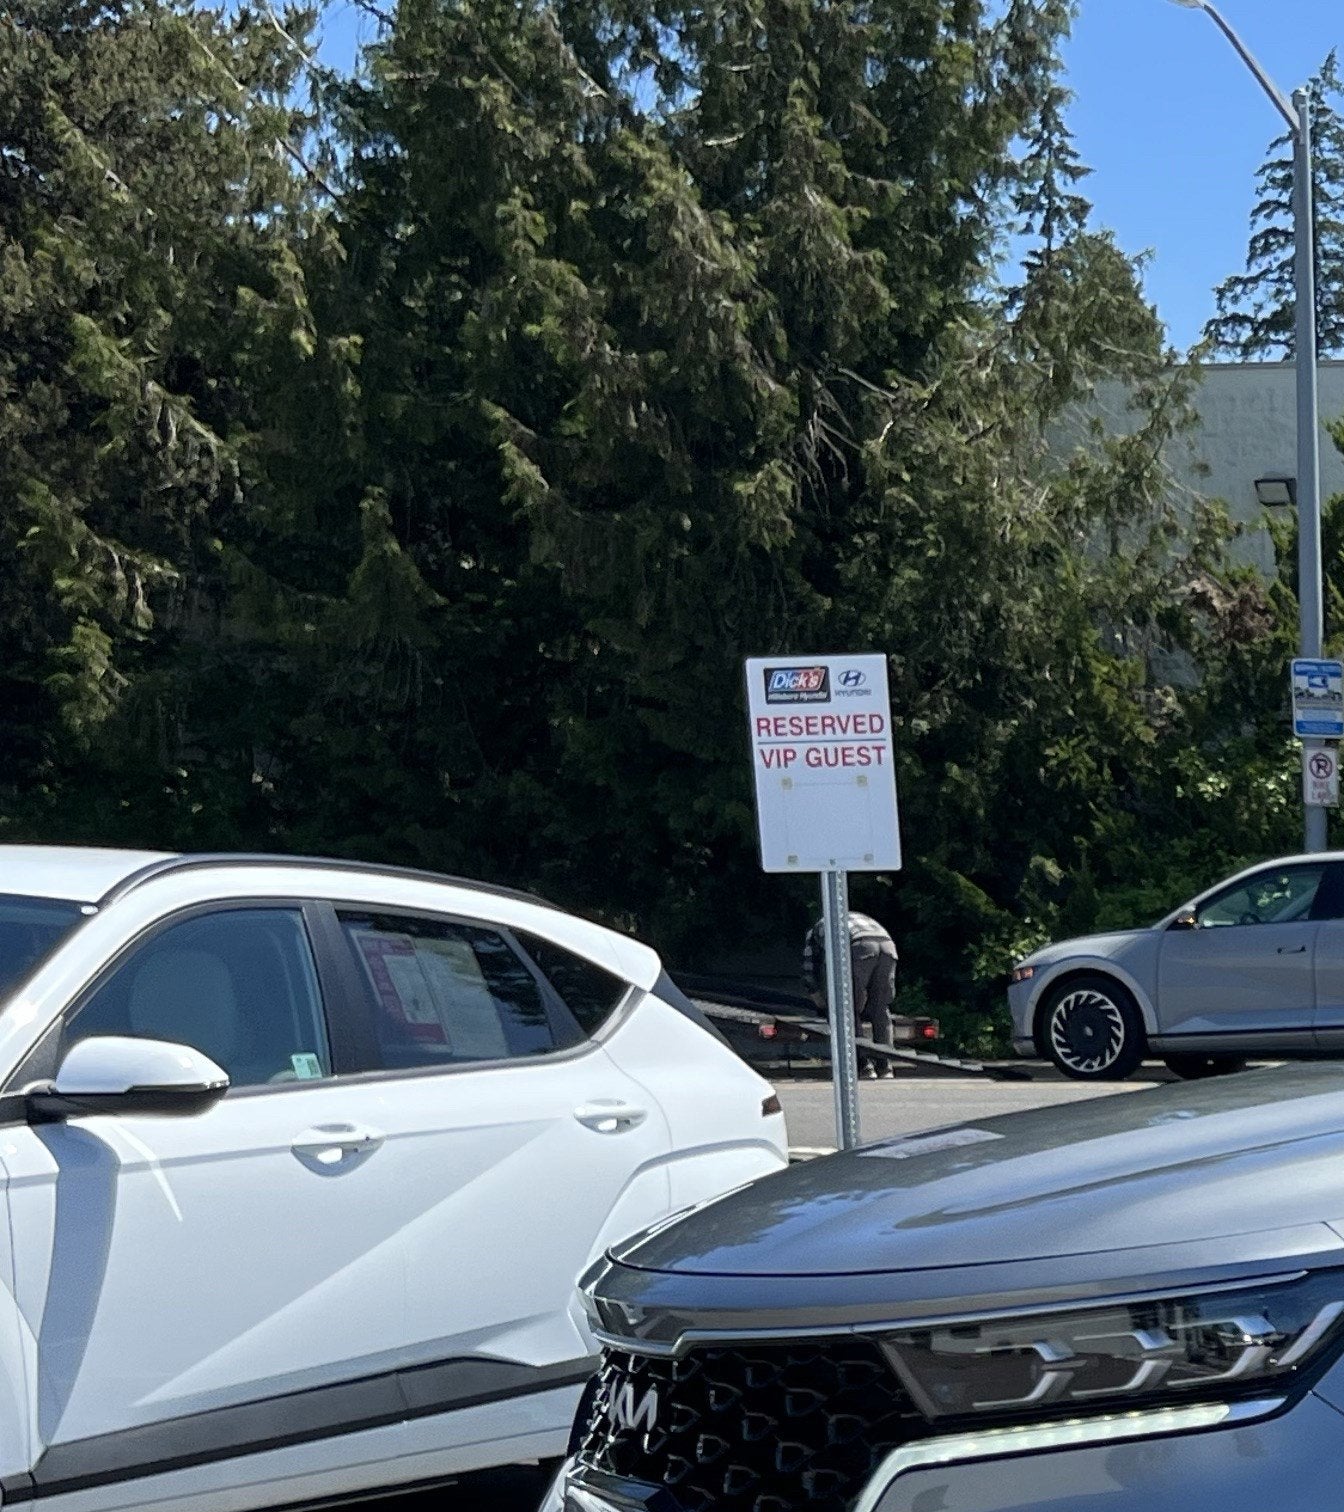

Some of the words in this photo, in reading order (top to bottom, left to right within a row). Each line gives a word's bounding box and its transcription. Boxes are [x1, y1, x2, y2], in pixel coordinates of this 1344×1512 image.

[756, 713, 884, 738] RESERVED
[760, 747, 798, 769] VIP
[805, 745, 886, 768] GUEST
